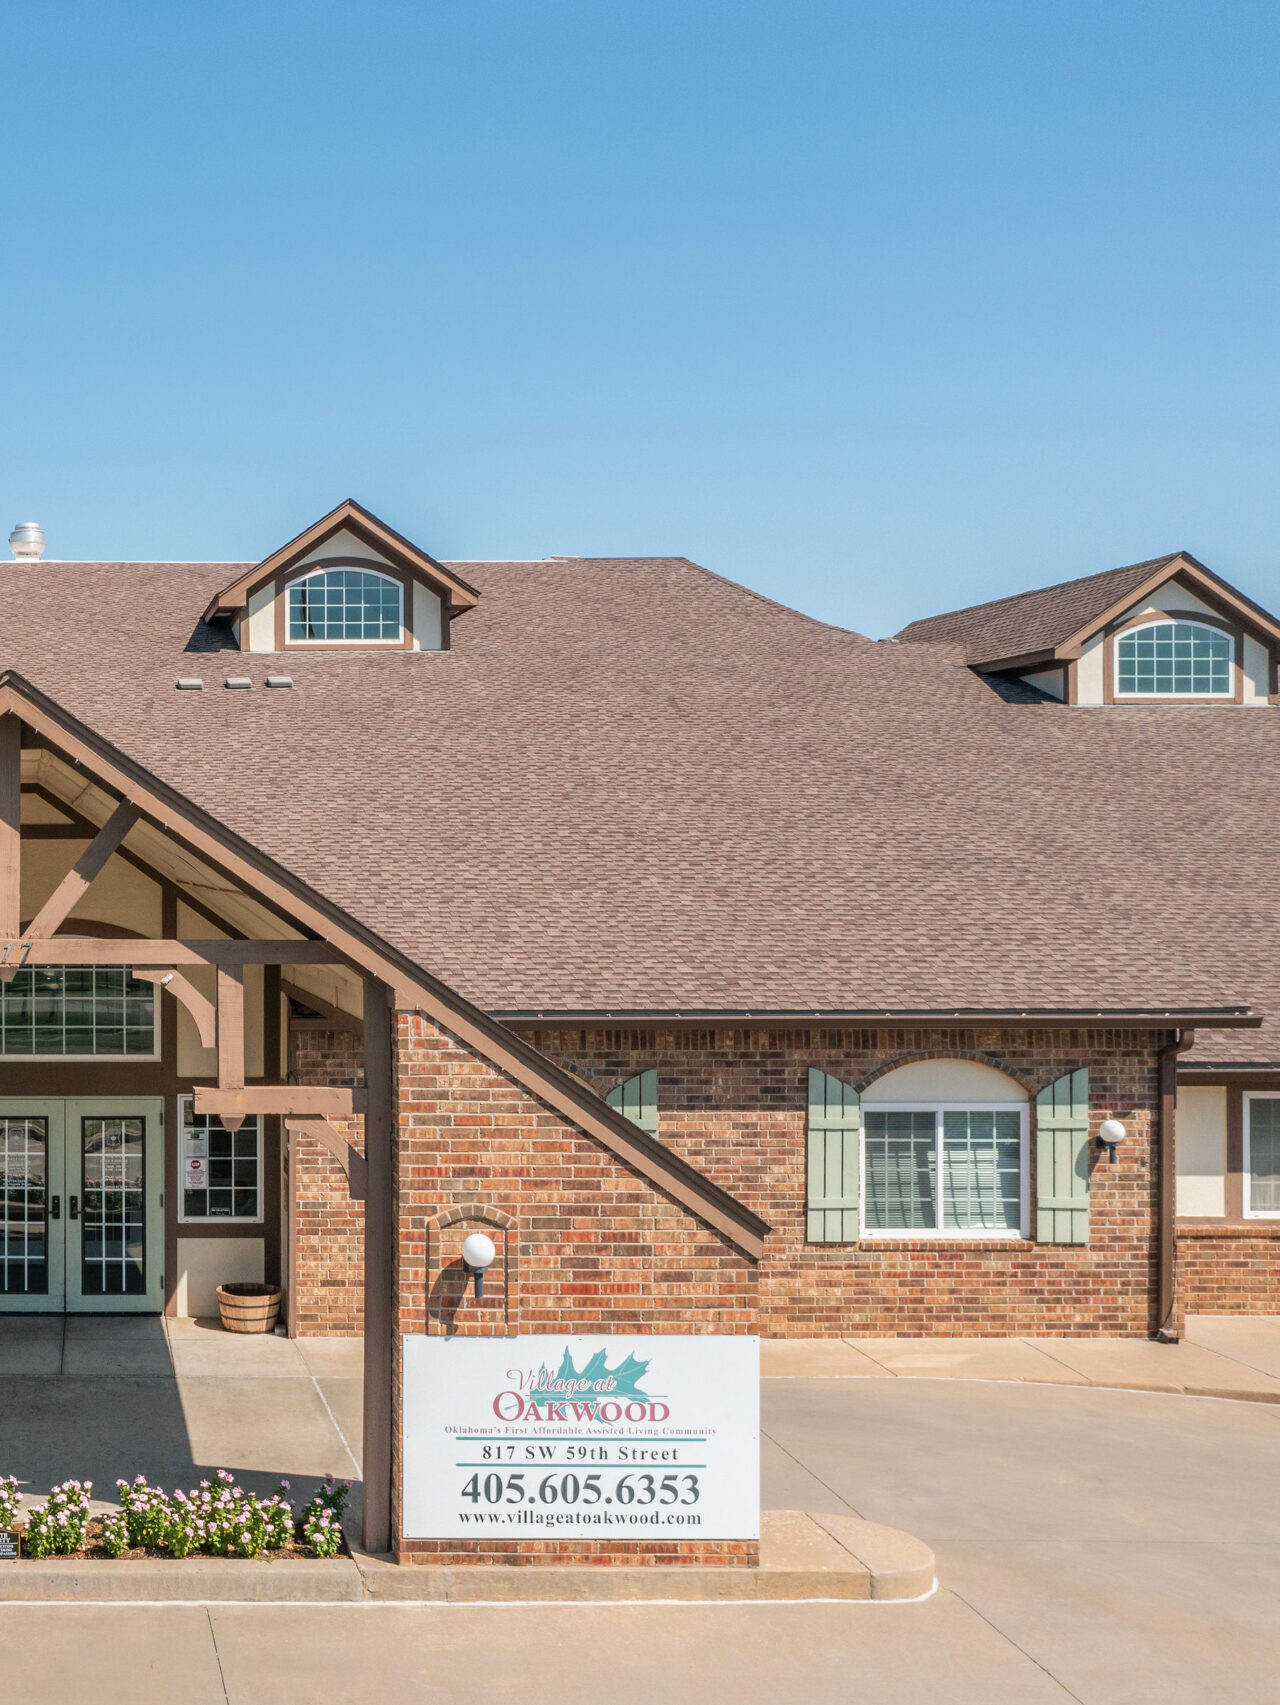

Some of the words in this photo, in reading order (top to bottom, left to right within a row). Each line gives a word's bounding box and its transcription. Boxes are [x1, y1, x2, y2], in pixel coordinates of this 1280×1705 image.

[506, 1369, 590, 1398] Village
[593, 1375, 617, 1391] at
[493, 1391, 670, 1422] OAKWOOD
[445, 1426, 501, 1434] Oklahoma's
[505, 1426, 528, 1434] First
[532, 1426, 583, 1435] Affordable
[586, 1427, 624, 1435] Assisted
[628, 1427, 659, 1436] Living
[662, 1427, 718, 1436] Community
[482, 1445, 515, 1460] 817
[525, 1445, 557, 1460] SW
[566, 1445, 608, 1460] 59th
[618, 1446, 679, 1461] Street
[461, 1473, 700, 1505] 405.605.6353
[458, 1510, 702, 1527] www.villageatoakwood.com
